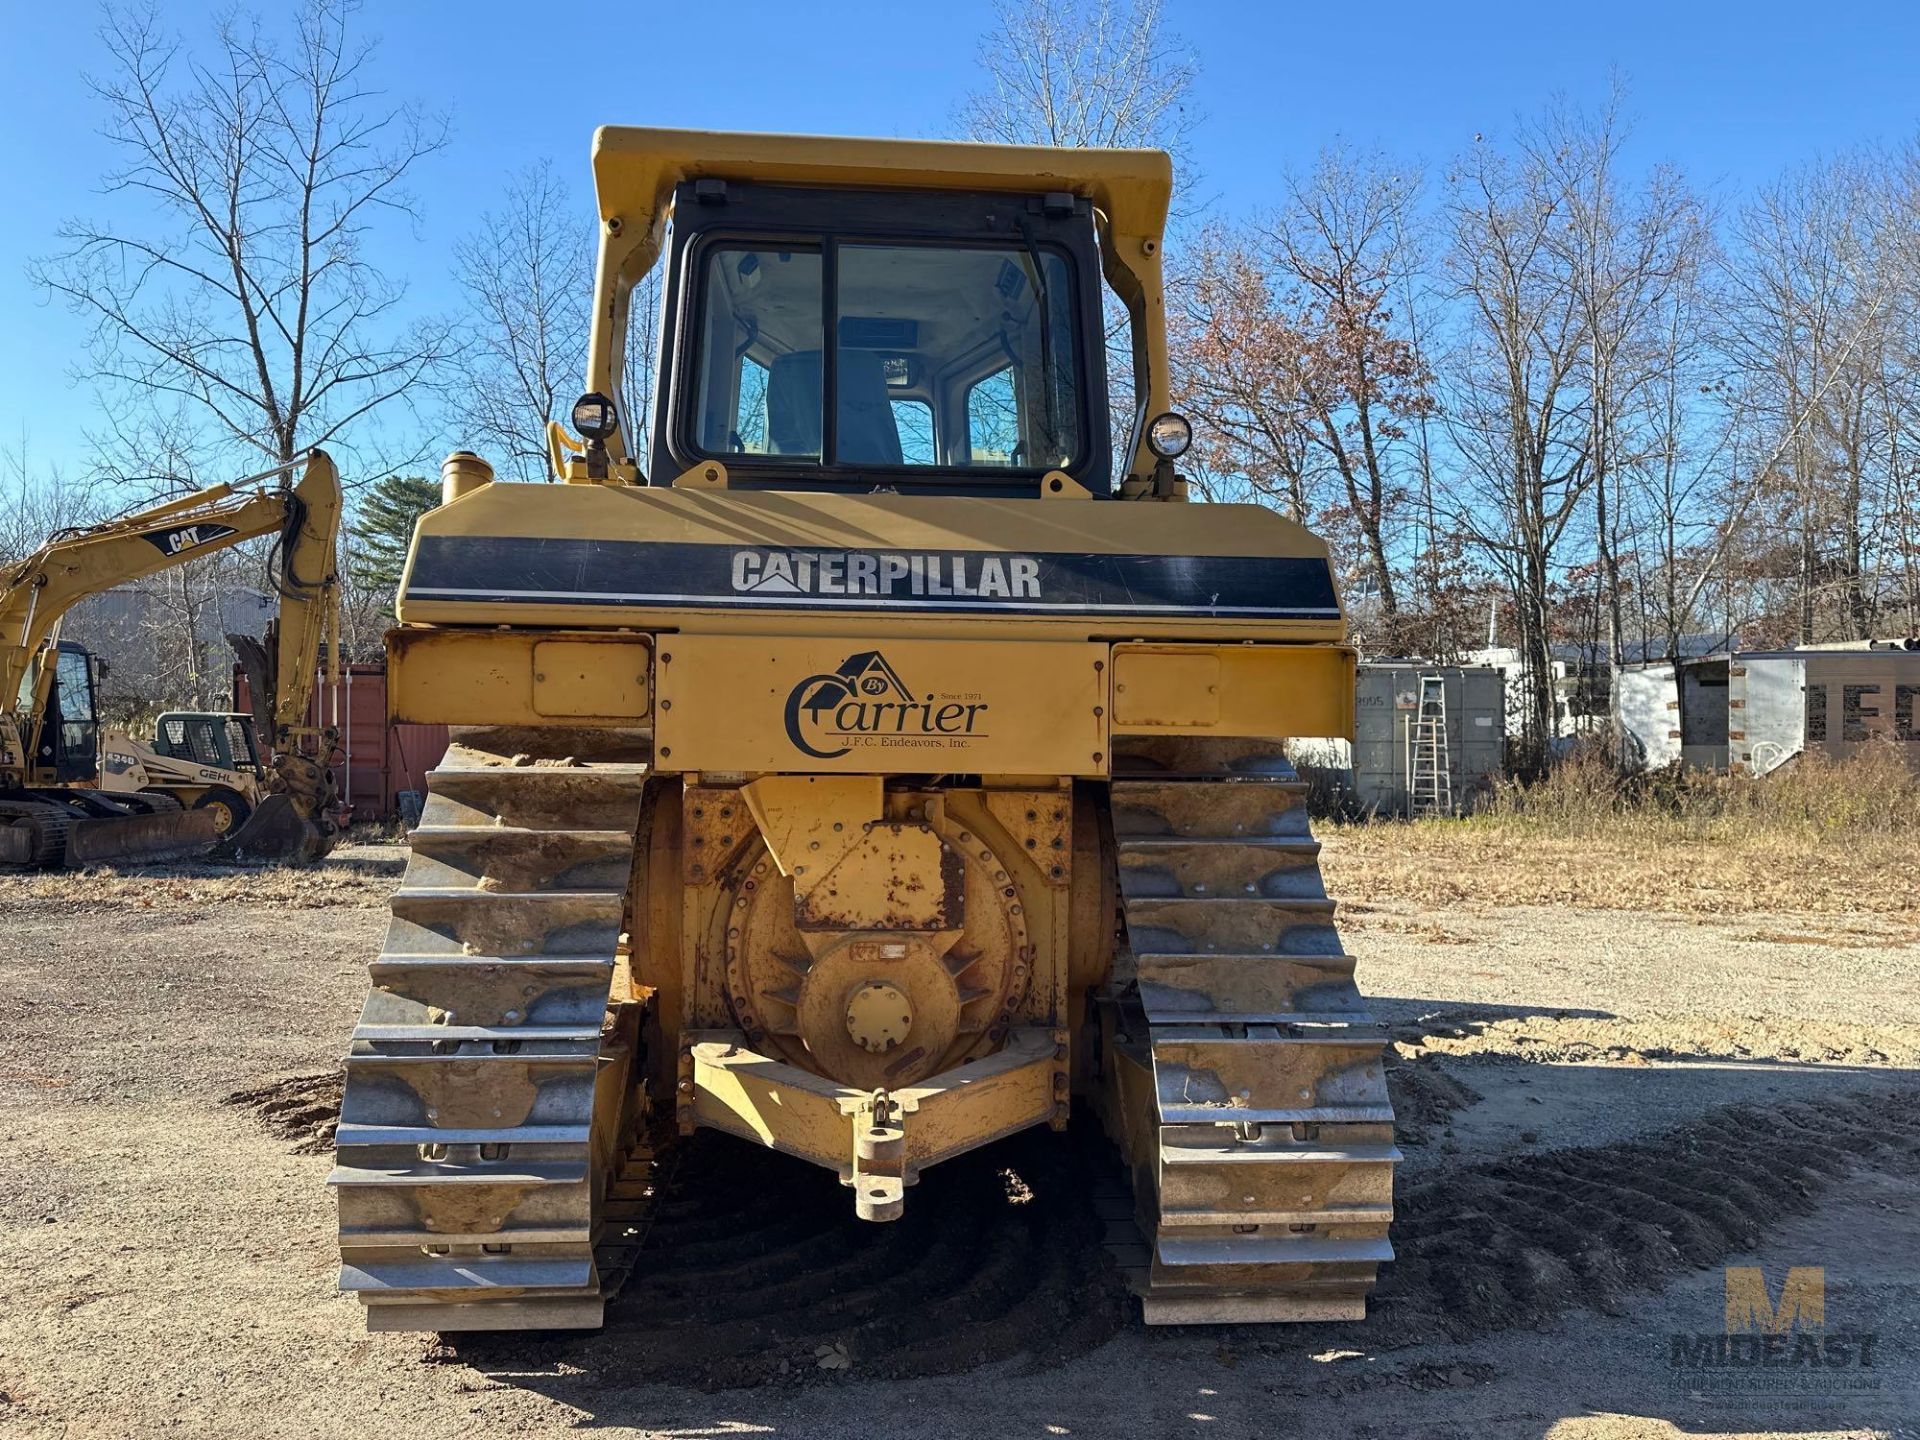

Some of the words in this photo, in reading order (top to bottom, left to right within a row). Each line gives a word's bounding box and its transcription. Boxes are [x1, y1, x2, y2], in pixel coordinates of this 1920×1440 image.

[169, 526, 200, 552] CAT
[731, 550, 1042, 598] CATERPILLAR
[865, 679, 885, 694] By
[940, 692, 961, 700] Since
[965, 692, 982, 700] 1971
[784, 674, 989, 759] Carrier
[841, 736, 876, 747] J.F.C.
[881, 736, 945, 749] Endeavors,
[949, 738, 971, 748] Inc.
[200, 768, 234, 784] GEHL
